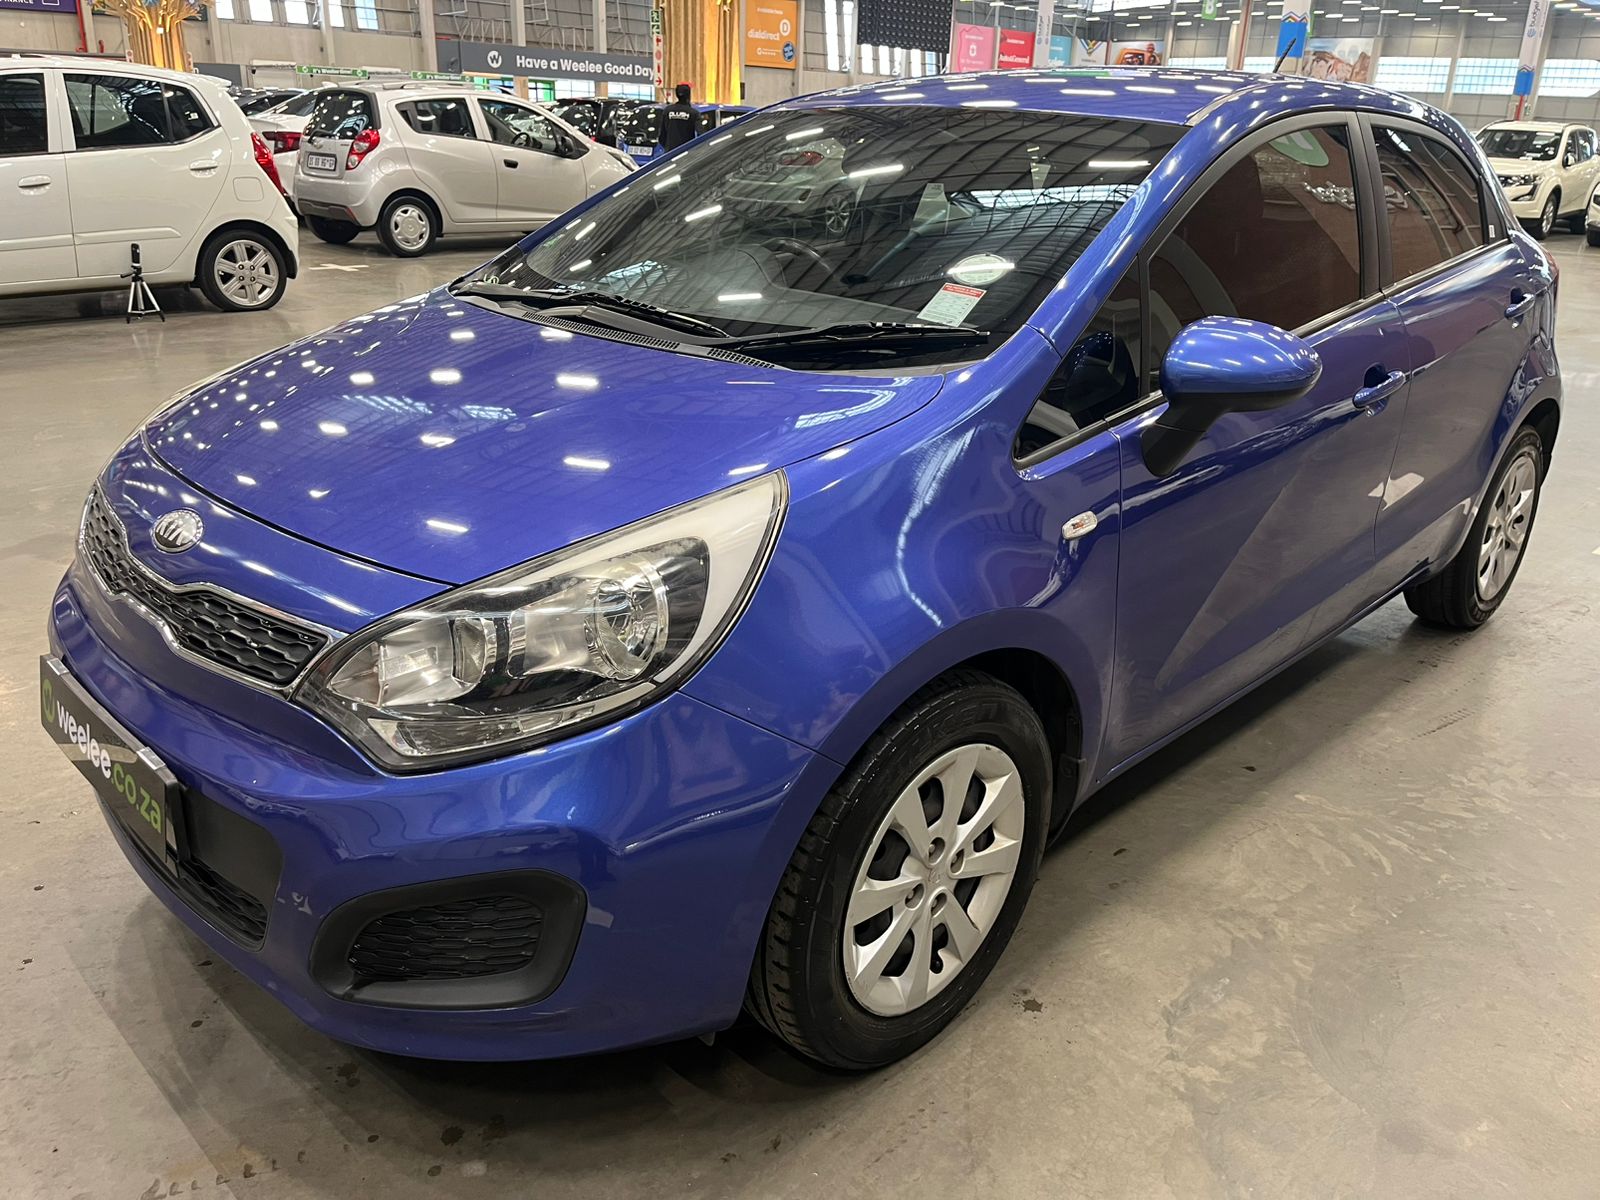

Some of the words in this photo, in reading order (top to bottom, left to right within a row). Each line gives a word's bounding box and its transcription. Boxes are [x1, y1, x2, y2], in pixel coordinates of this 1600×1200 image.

[516, 54, 548, 70] Have
[549, 61, 558, 70] a
[560, 60, 603, 73] Weelee
[604, 62, 633, 76] Good
[634, 65, 654, 80] Day
[57, 700, 162, 833] weelee.co.za
